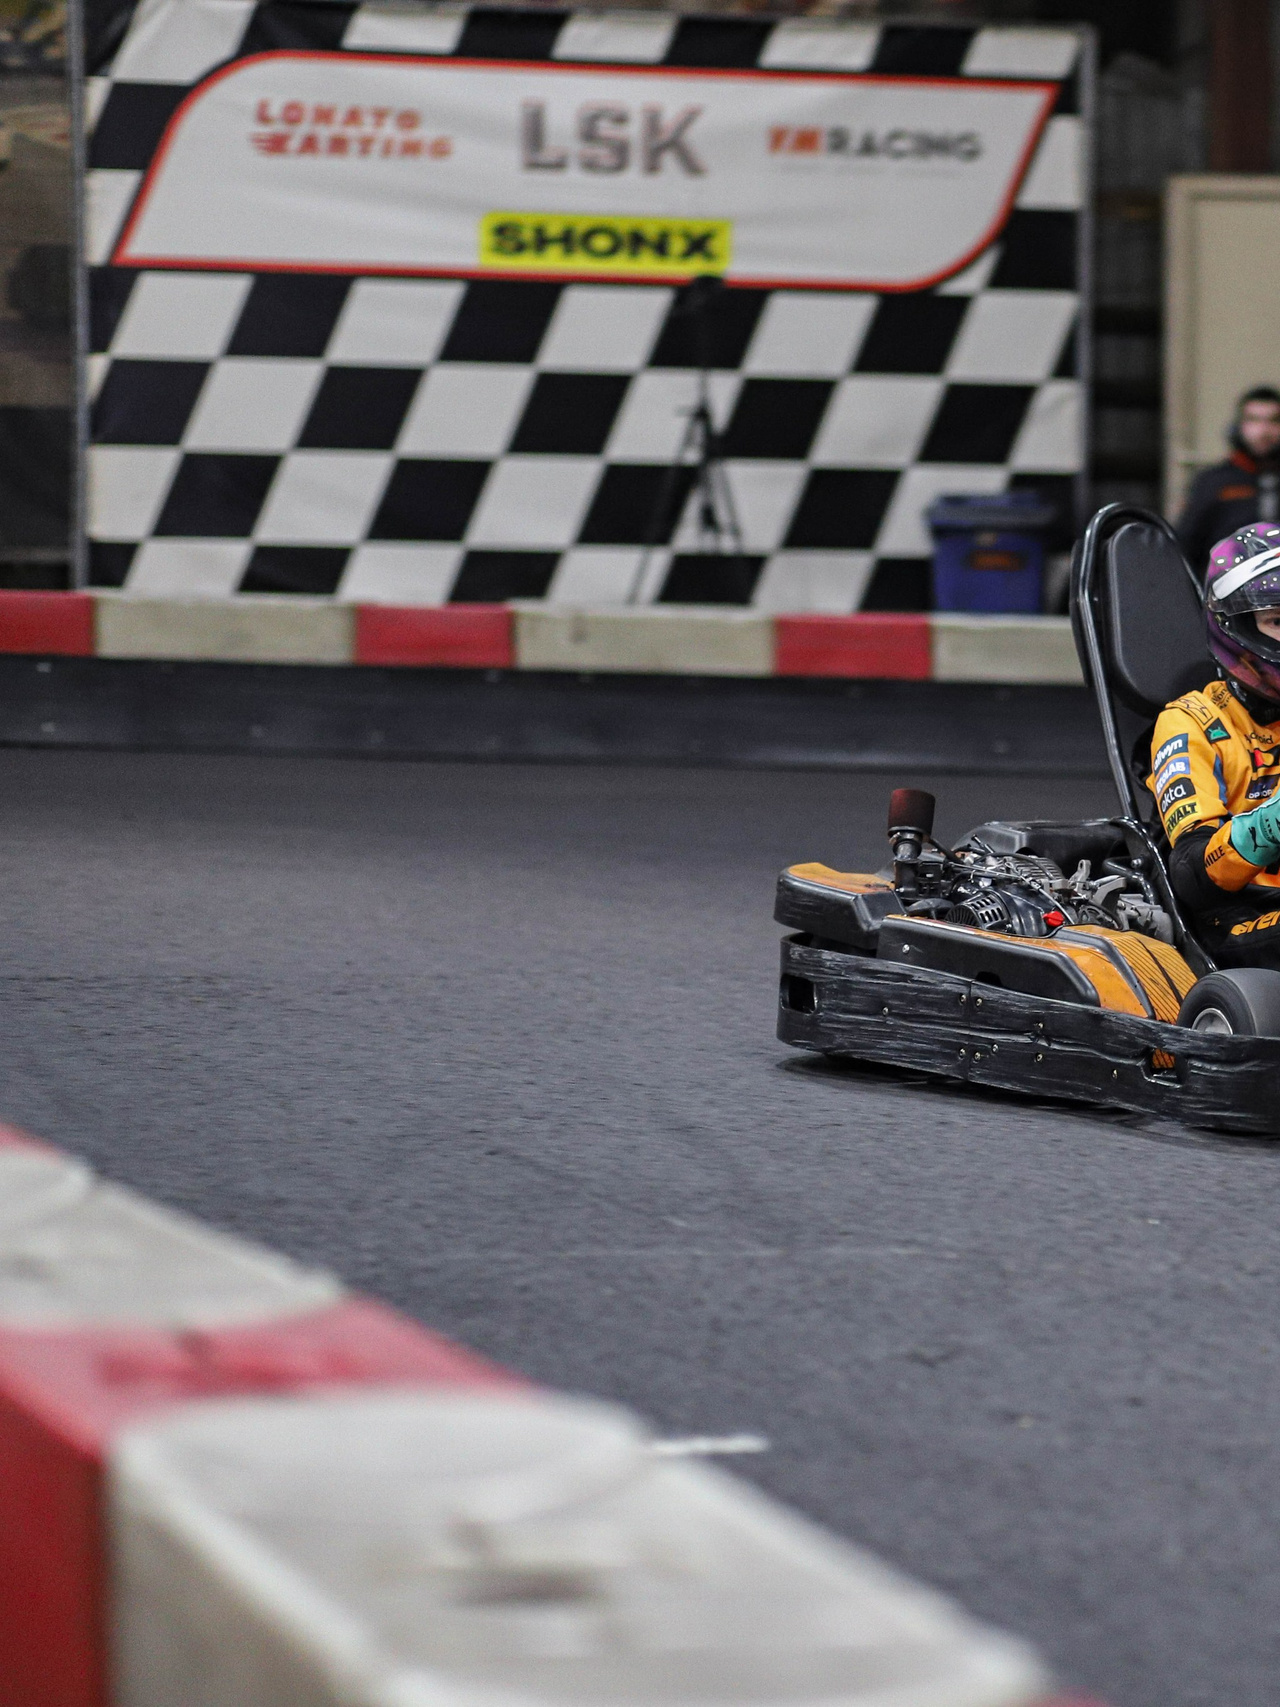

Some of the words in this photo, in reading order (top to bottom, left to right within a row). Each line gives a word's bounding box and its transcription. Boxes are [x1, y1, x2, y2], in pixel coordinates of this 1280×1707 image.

[256, 100, 421, 130] LONATO
[520, 99, 708, 176] LSK
[490, 221, 720, 264] SHONX
[1161, 784, 1187, 813] okta
